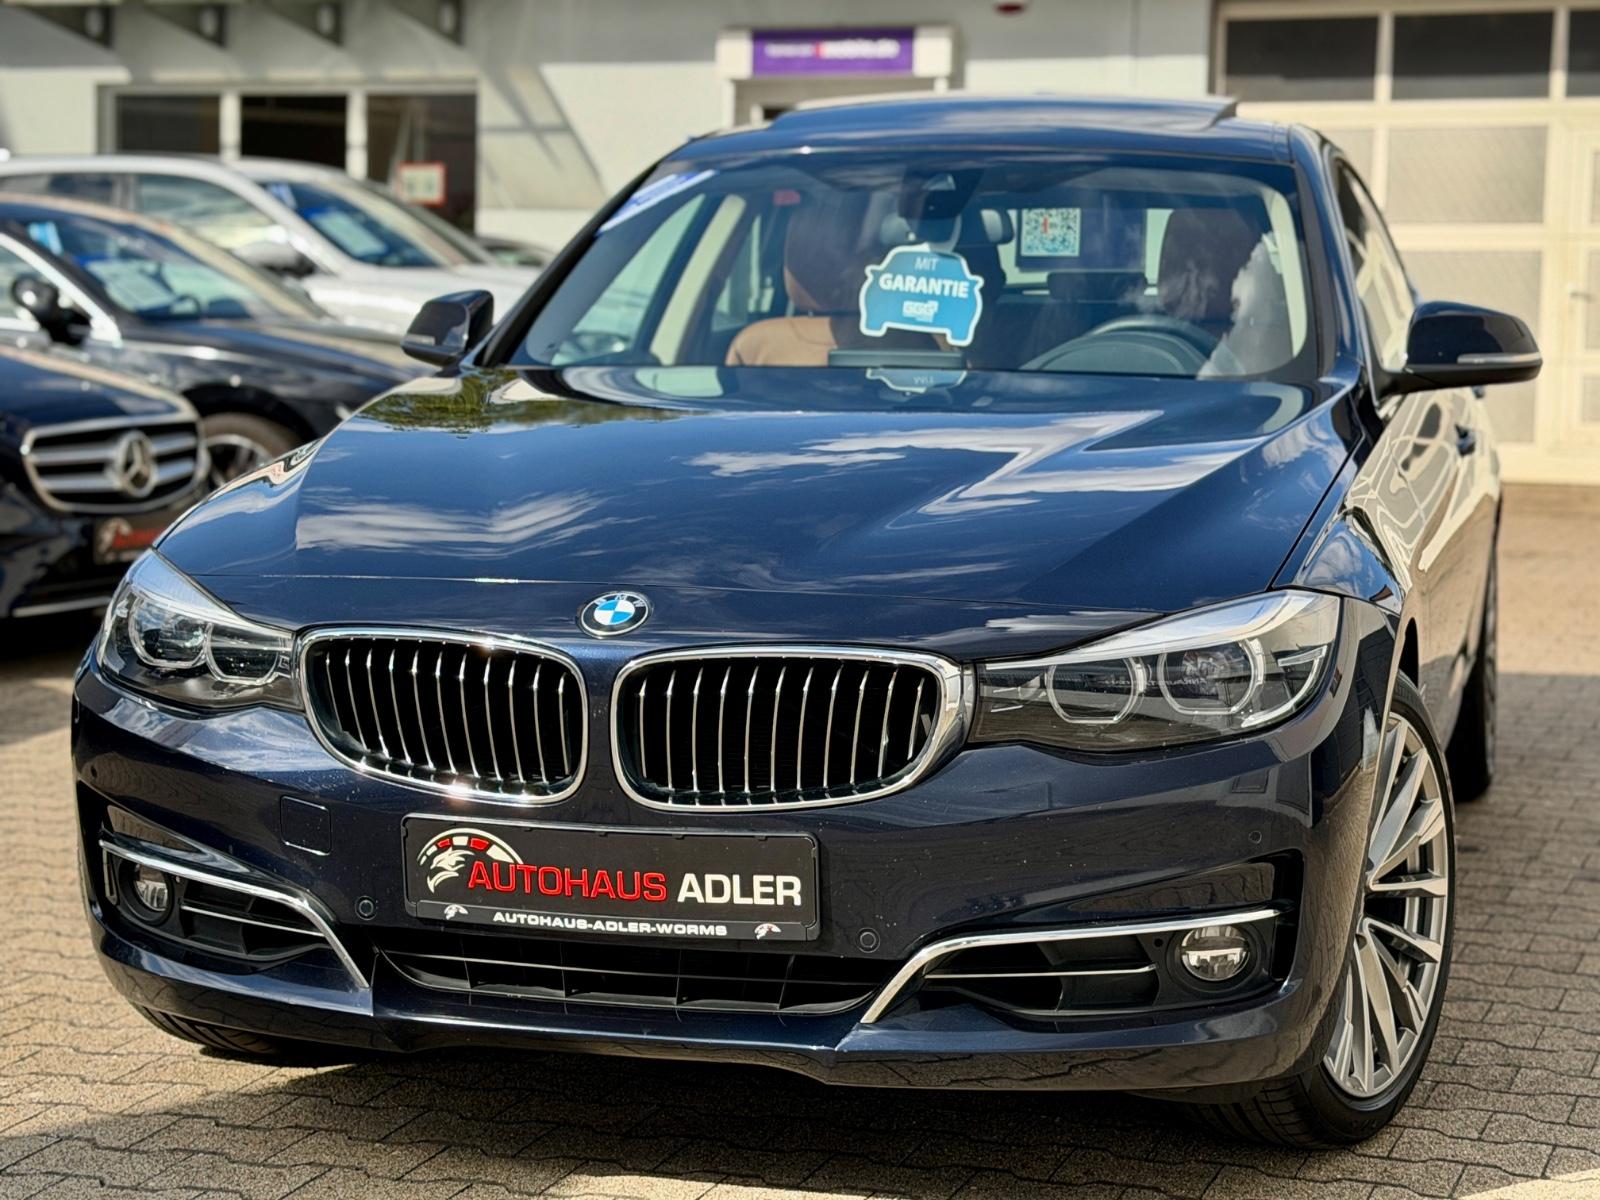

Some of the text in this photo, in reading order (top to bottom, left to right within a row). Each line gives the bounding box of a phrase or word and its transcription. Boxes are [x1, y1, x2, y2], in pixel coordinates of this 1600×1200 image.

[914, 257, 939, 271] MIT
[879, 273, 970, 299] GARANTIE
[468, 860, 802, 906] AUTOHAUS ADLER
[493, 911, 728, 936] AUTOHAUS-ADLER-WORMS
